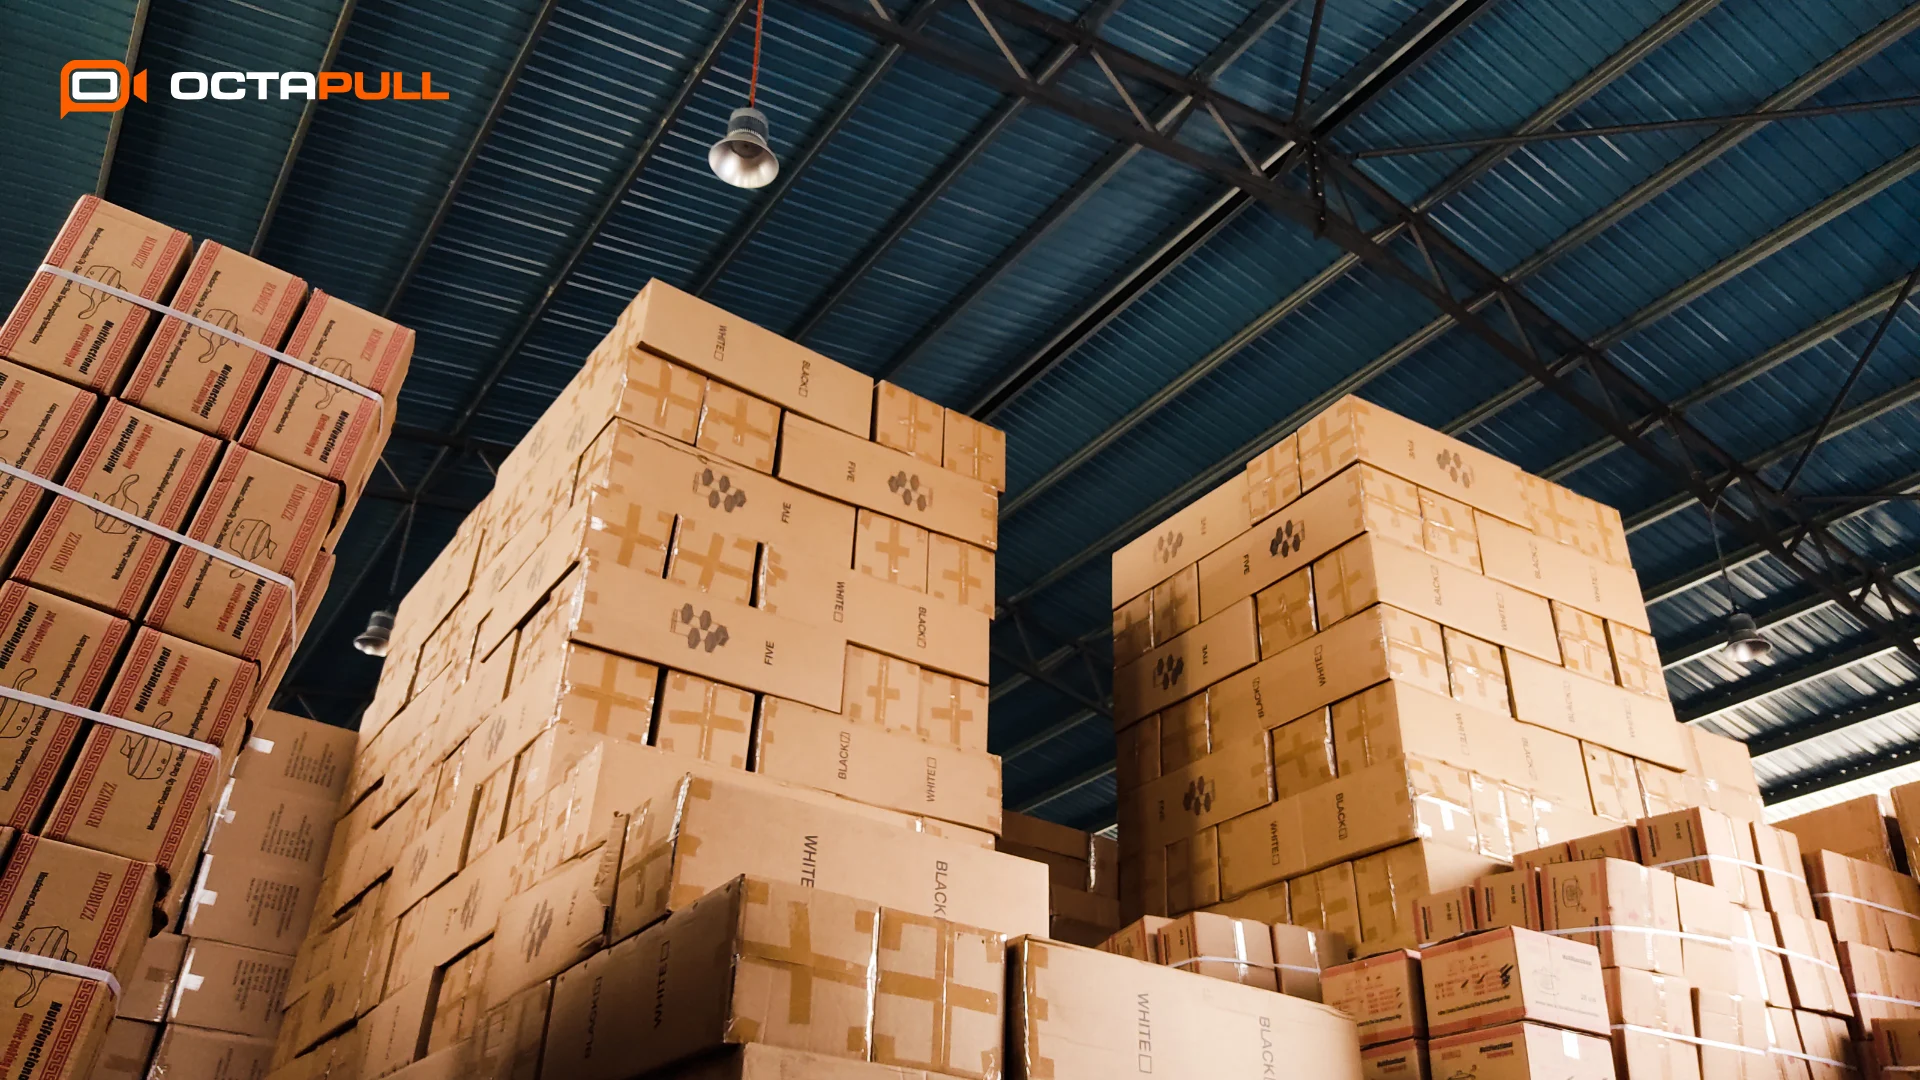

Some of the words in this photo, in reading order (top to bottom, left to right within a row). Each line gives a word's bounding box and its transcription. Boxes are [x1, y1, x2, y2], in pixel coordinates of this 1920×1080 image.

[132, 236, 156, 268] REDBUZZ
[252, 282, 276, 315] REDBUZZ
[79, 320, 113, 374] Multifunctional
[716, 325, 727, 352] WHITE
[200, 364, 231, 418] Multifunctional
[800, 360, 811, 387] BLACK
[103, 417, 138, 473] Multifunctional
[320, 411, 348, 463] Multifunctional
[846, 460, 856, 482] FIVE
[281, 484, 307, 521] REDBUZZ
[781, 502, 792, 524] FIVE
[50, 532, 81, 572] REDBUZZ
[232, 579, 265, 639] Multifunctional
[834, 581, 845, 611] WHITE
[20, 641, 39, 663] Electric
[33, 620, 52, 642] cooking
[45, 610, 56, 622] pot
[917, 606, 927, 638] BLACK
[764, 640, 775, 666] FIVE
[1314, 655, 1327, 687] WHITE
[135, 647, 171, 712] Multifunctional
[157, 685, 174, 706] Electric
[168, 665, 185, 686] cooking
[178, 655, 188, 666] pot
[837, 743, 849, 780] BLACK
[926, 769, 936, 802] WHITE
[86, 782, 117, 828] REDBUZZ
[1335, 793, 1347, 828] BLACK
[1269, 820, 1280, 853] WHITE
[800, 835, 819, 888] WHITE
[80, 872, 112, 920] REDBUZZ
[933, 860, 948, 916] BLACK
[654, 963, 668, 1030] WHITE
[13, 1013, 33, 1040] Electric
[19, 1002, 62, 1080] Multifunctiona
[1137, 993, 1151, 1052] WHITE
[0, 1040, 21, 1067] cooking
[1258, 1016, 1276, 1075] BLACK
